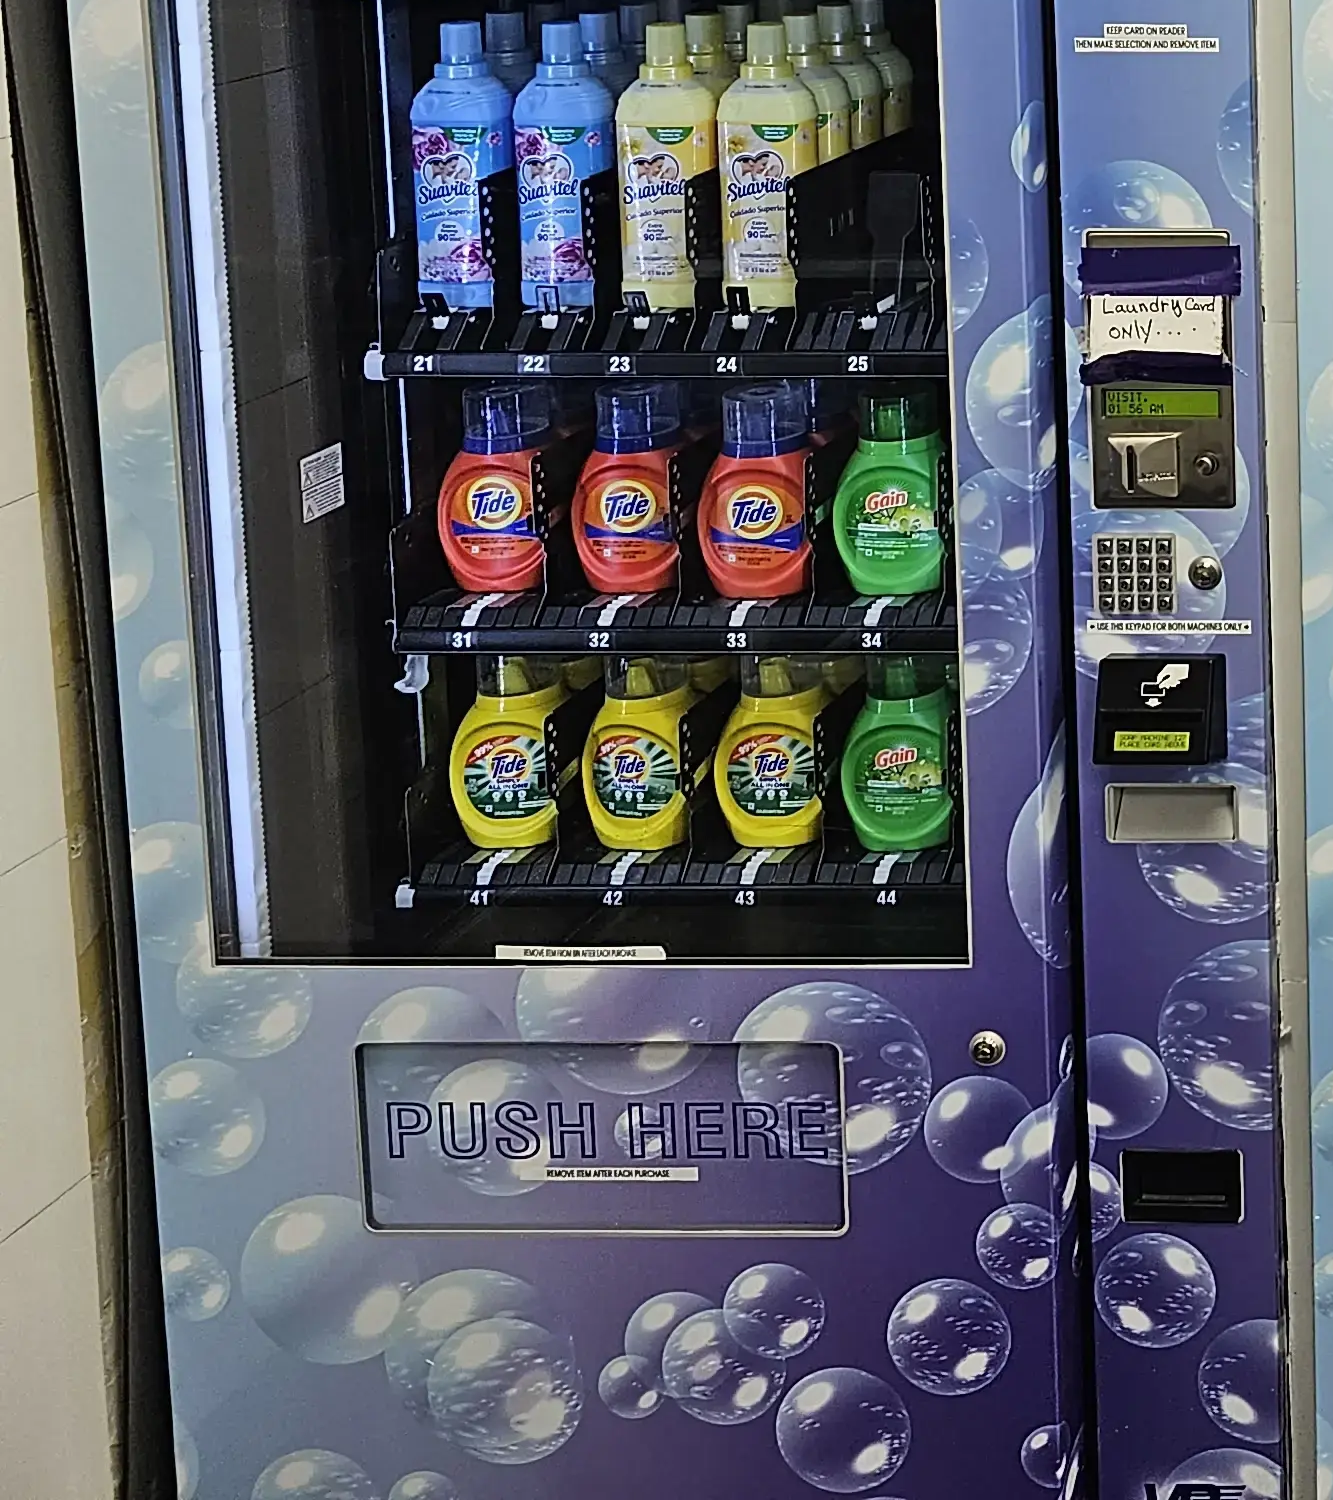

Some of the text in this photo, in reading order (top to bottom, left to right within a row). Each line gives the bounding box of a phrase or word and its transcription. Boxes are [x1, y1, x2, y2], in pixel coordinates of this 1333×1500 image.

[1106, 26, 1186, 35] KEEP CARD ON READER
[1076, 40, 1217, 49] THEN MAKE SELECTION AND REMOVE ITEM
[519, 179, 579, 204] Suavitel
[727, 176, 790, 202] Suavitel
[1102, 296, 1182, 318] Laundry
[413, 354, 434, 372] 21
[523, 355, 545, 372] 22
[609, 355, 631, 373] 23
[716, 356, 738, 373] 24
[847, 355, 869, 372] 25
[1149, 404, 1165, 414] AM
[472, 489, 516, 521] Tide
[605, 491, 650, 525] Tide
[865, 488, 909, 512] Gain
[732, 498, 777, 531] Tide
[1096, 622, 1242, 631] USE THIS KEYPAD FOR BOTH MACHINES ONLY
[451, 631, 472, 648] 31
[588, 632, 610, 648] 32
[726, 632, 747, 648] 33
[861, 632, 882, 648] 34
[491, 753, 528, 779] Tide
[614, 753, 646, 777] Tide
[753, 753, 790, 779] Tide
[874, 746, 917, 771] Gain
[385, 1100, 829, 1162] PUSH HERE
[546, 1169, 670, 1178] REMOVE ITEM AFTER EACH PURCHASE
